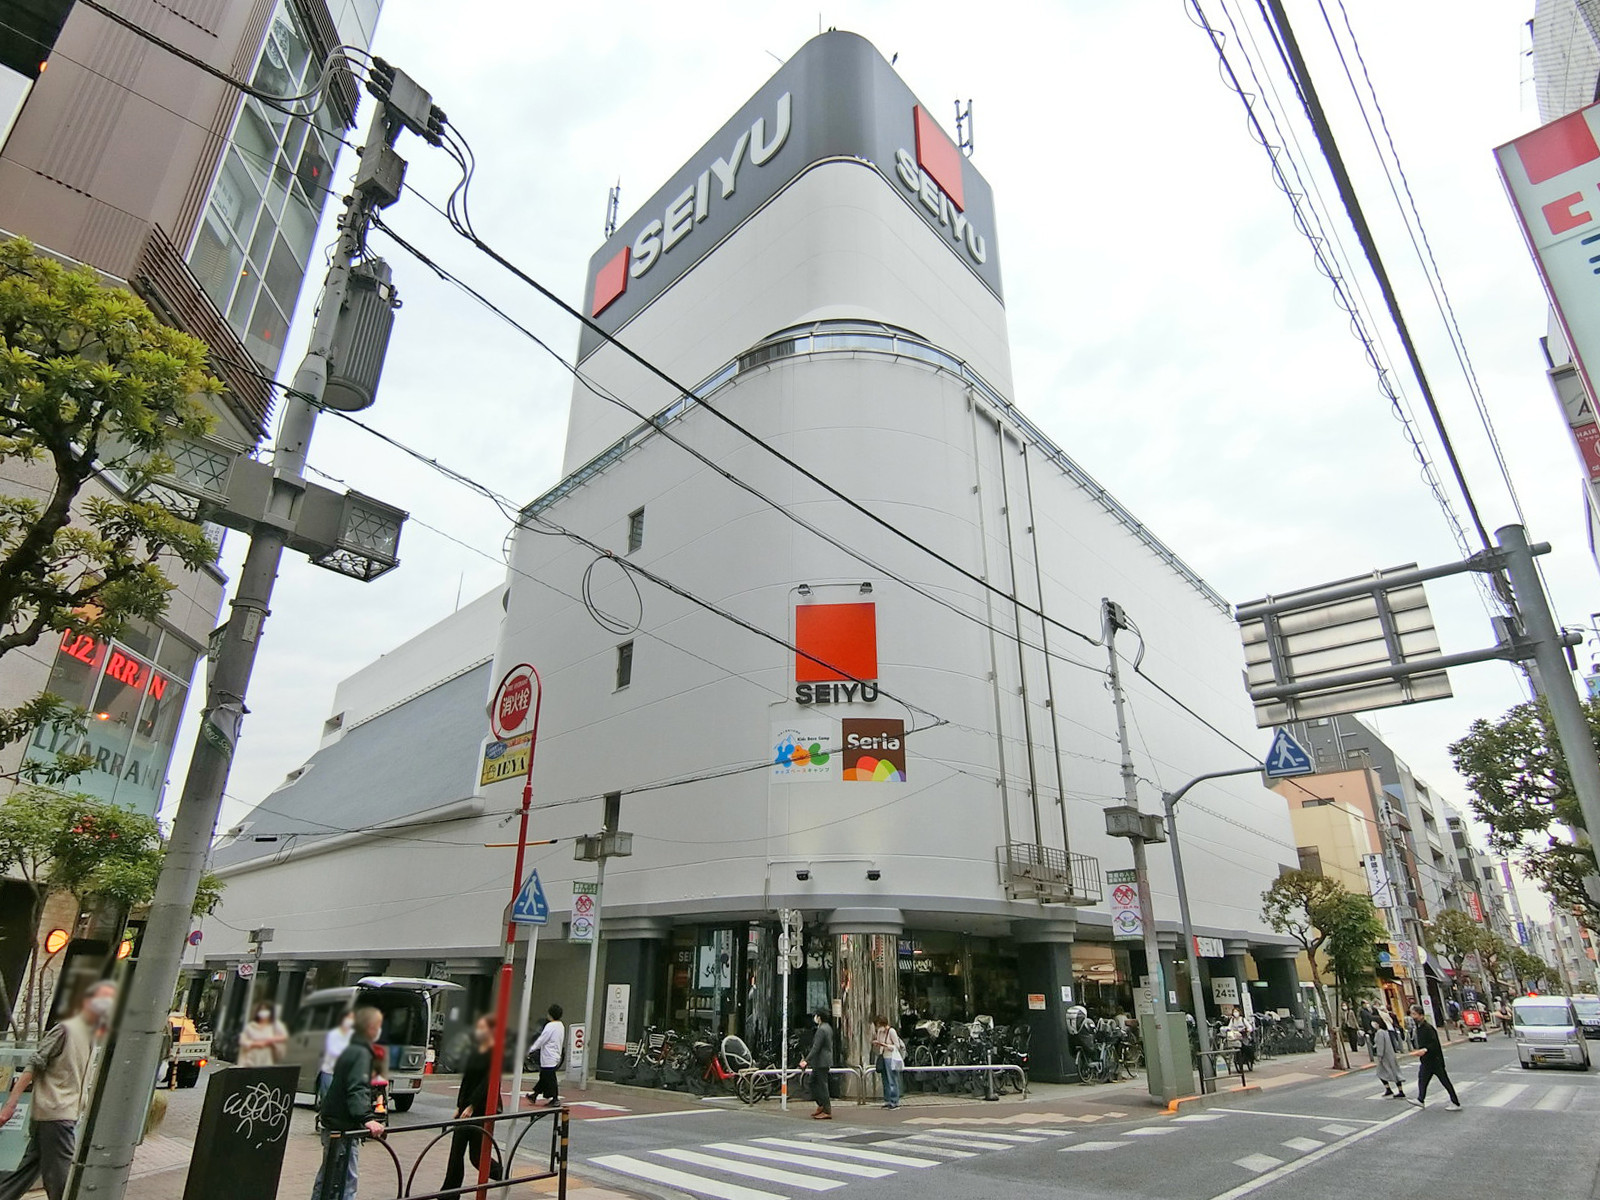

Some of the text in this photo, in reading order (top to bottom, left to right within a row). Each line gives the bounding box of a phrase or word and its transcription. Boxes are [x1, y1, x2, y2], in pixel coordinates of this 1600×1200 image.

[630, 91, 791, 279] SEIYU
[895, 147, 987, 265] SEIYU
[501, 687, 530, 718] 消火栓
[795, 682, 879, 705] SEIYU
[847, 732, 901, 751] Seria
[1215, 989, 1228, 998] 24
